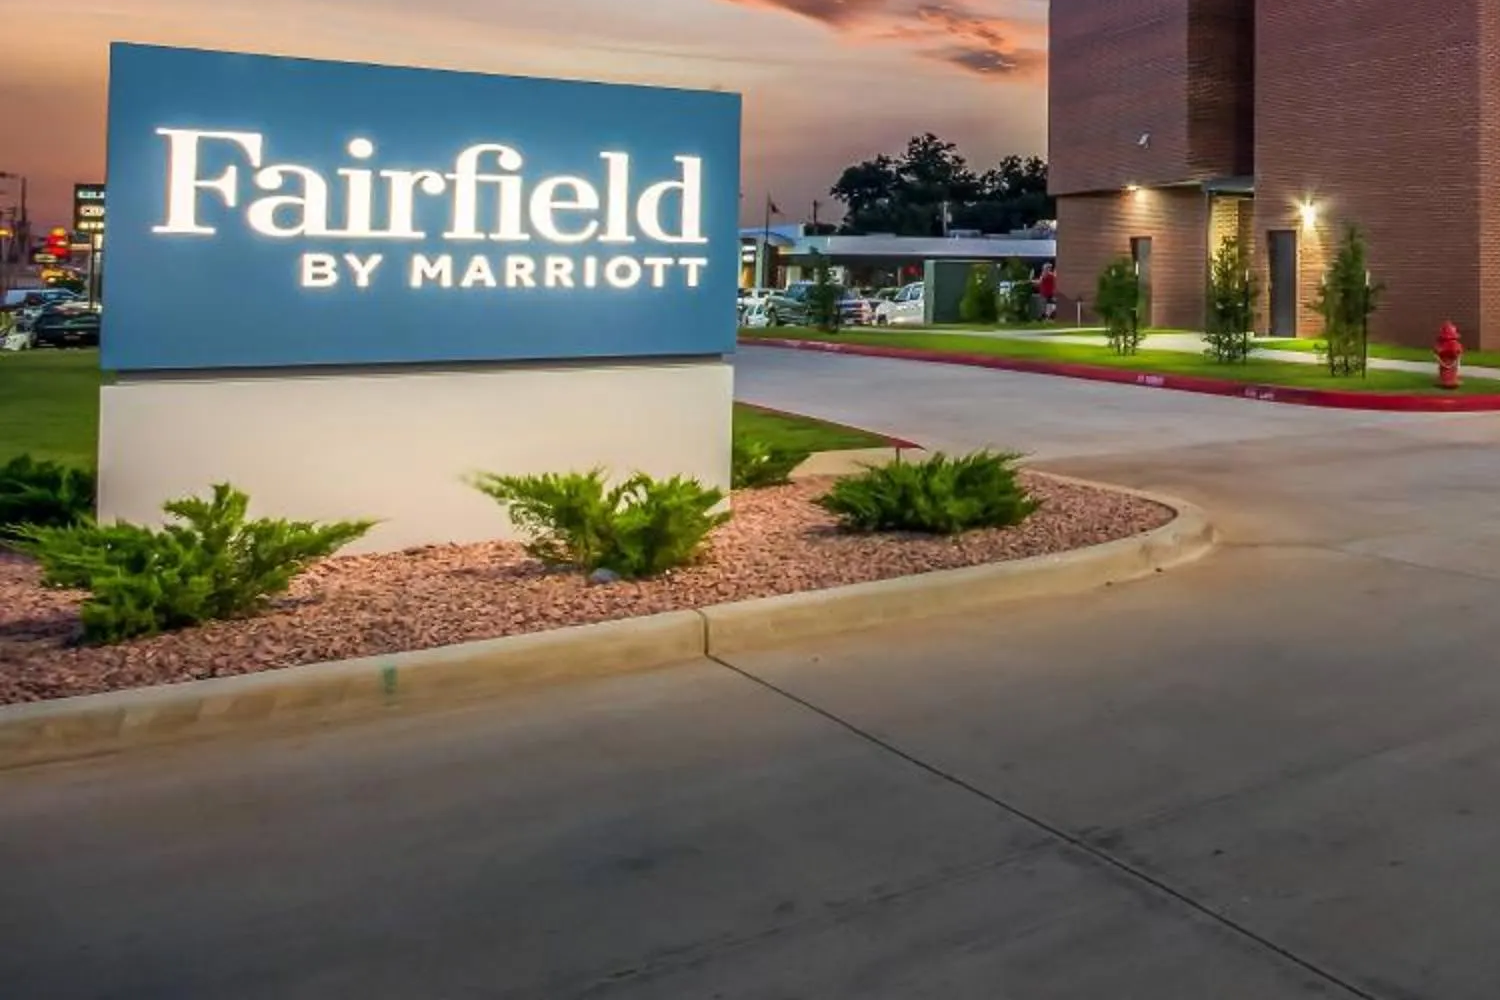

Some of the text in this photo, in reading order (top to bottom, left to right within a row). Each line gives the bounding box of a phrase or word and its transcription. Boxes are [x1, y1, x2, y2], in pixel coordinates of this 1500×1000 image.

[151, 127, 709, 244] Fairfield
[301, 252, 708, 289] BY MARRIOTT
